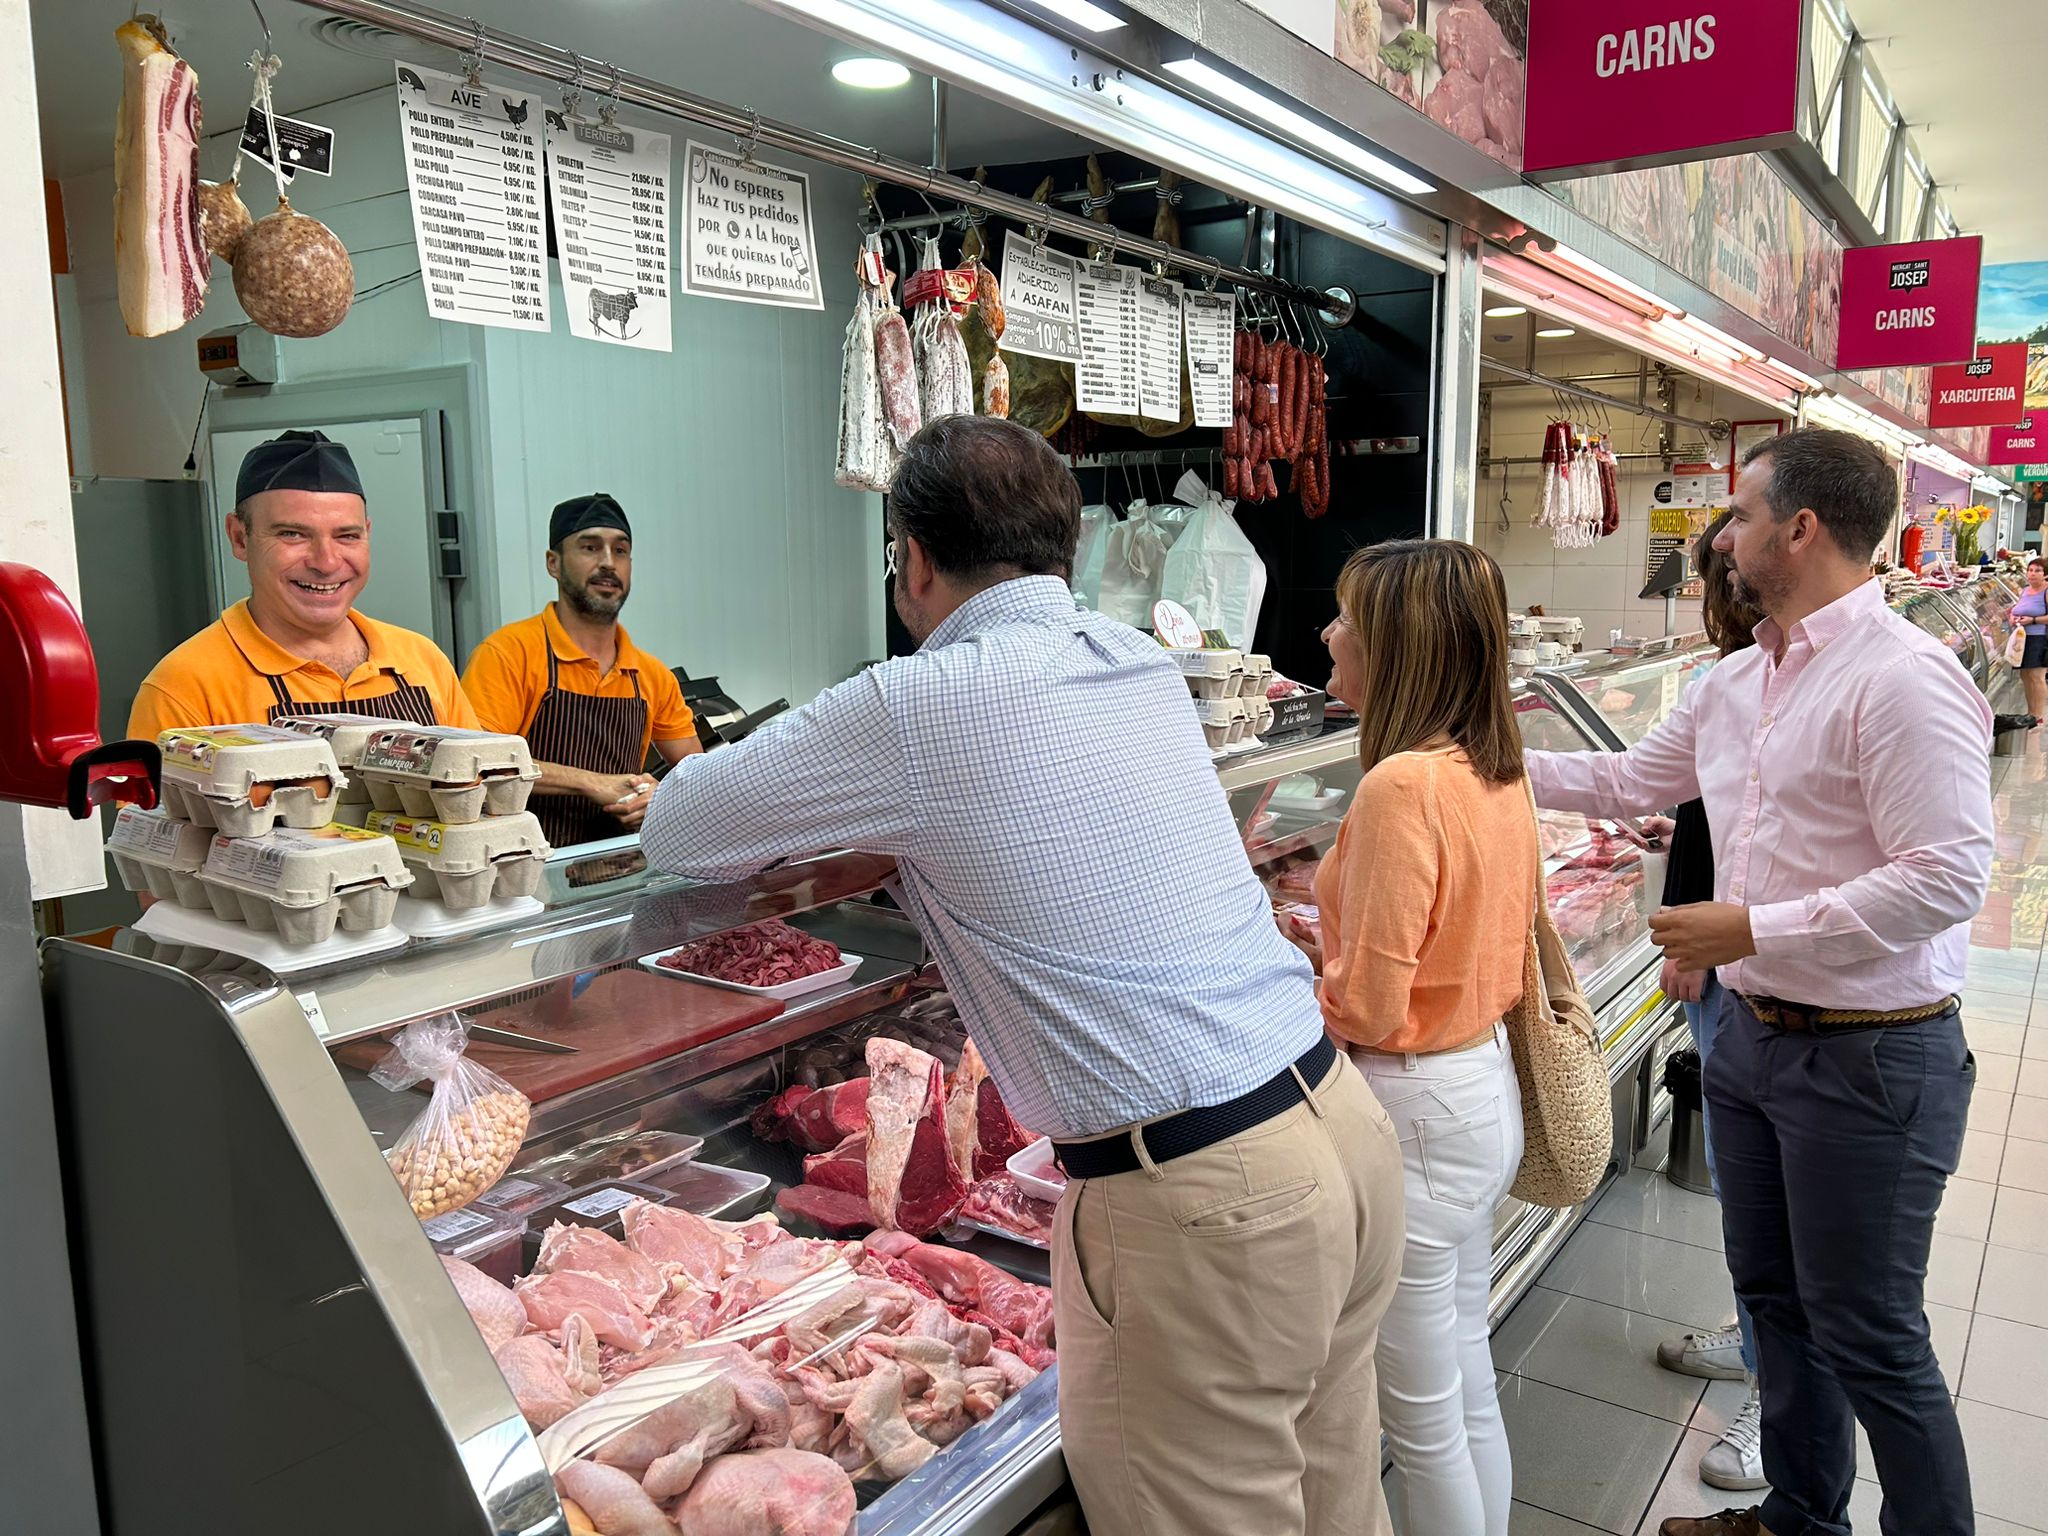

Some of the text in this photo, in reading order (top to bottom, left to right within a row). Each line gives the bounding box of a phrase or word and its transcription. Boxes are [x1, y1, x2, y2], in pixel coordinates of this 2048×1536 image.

[1595, 14, 1716, 79] CARNS
[451, 90, 482, 109] AVE
[409, 110, 429, 123] POLLO
[430, 114, 455, 129] ENTERO
[500, 131, 518, 143] 4,50€
[579, 125, 628, 147] TERNERA
[410, 126, 430, 139] POLLO
[430, 131, 474, 148] PREPARACIÓN
[412, 142, 434, 156] MUSLO
[434, 147, 454, 160] POLLO
[503, 161, 521, 174] 4,95€
[414, 158, 430, 170] ALAS
[430, 162, 449, 174] POLLO
[503, 176, 521, 188] 4,95€
[416, 174, 445, 189] PECHUGA
[445, 180, 464, 192] POLLO
[709, 167, 729, 188] No
[418, 189, 457, 206] CODORNICES
[420, 205, 448, 220] CARCASA
[449, 210, 465, 222] PAVO
[507, 221, 525, 233] 5,95€
[422, 221, 440, 233] POLLO
[441, 224, 462, 238] CAMPO
[463, 228, 485, 241] ENTERO
[424, 236, 442, 249] POLLO
[442, 240, 464, 253] CAMPO
[464, 243, 505, 259] PREPARACIÓN
[427, 252, 453, 265] PECHUGA
[454, 257, 471, 268] PAVO
[1008, 251, 1072, 281] ESTABLECIMIENTO
[1914, 261, 1928, 269] SANT
[429, 267, 449, 280] MUSLO
[449, 271, 464, 282] PAVO
[1016, 271, 1059, 294] ADHERIDO
[1891, 270, 1928, 287] JOSEP
[434, 298, 455, 310] CONEJO
[1010, 288, 1070, 314] A ASAFAN
[1875, 306, 1936, 331] CARNS
[1036, 321, 1066, 354] 10%
[1966, 363, 1992, 375] JOSEP
[1939, 386, 2016, 404] XARCUTERIA
[2006, 438, 2036, 448] CARNS
[1651, 511, 1682, 533] CORDERO
[369, 741, 376, 754] 6
[379, 758, 414, 769] CAMPEROS
[429, 833, 439, 844] XL
